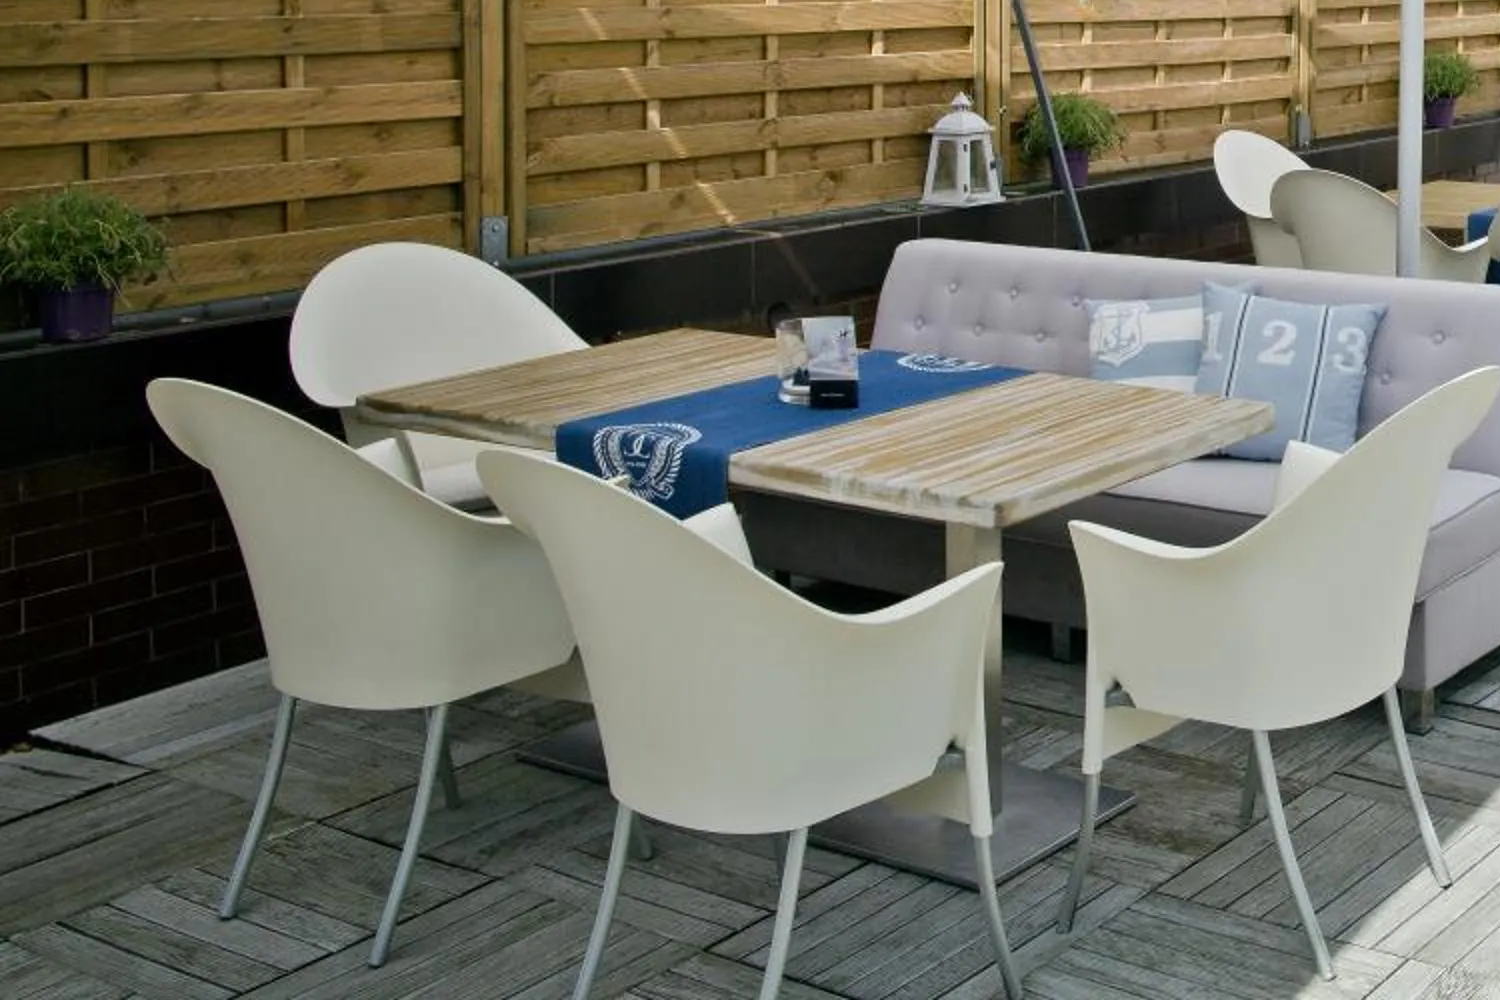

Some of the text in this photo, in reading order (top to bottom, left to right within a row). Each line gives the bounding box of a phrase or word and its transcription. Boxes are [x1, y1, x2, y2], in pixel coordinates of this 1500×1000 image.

[1201, 311, 1367, 373] 1 2 3
